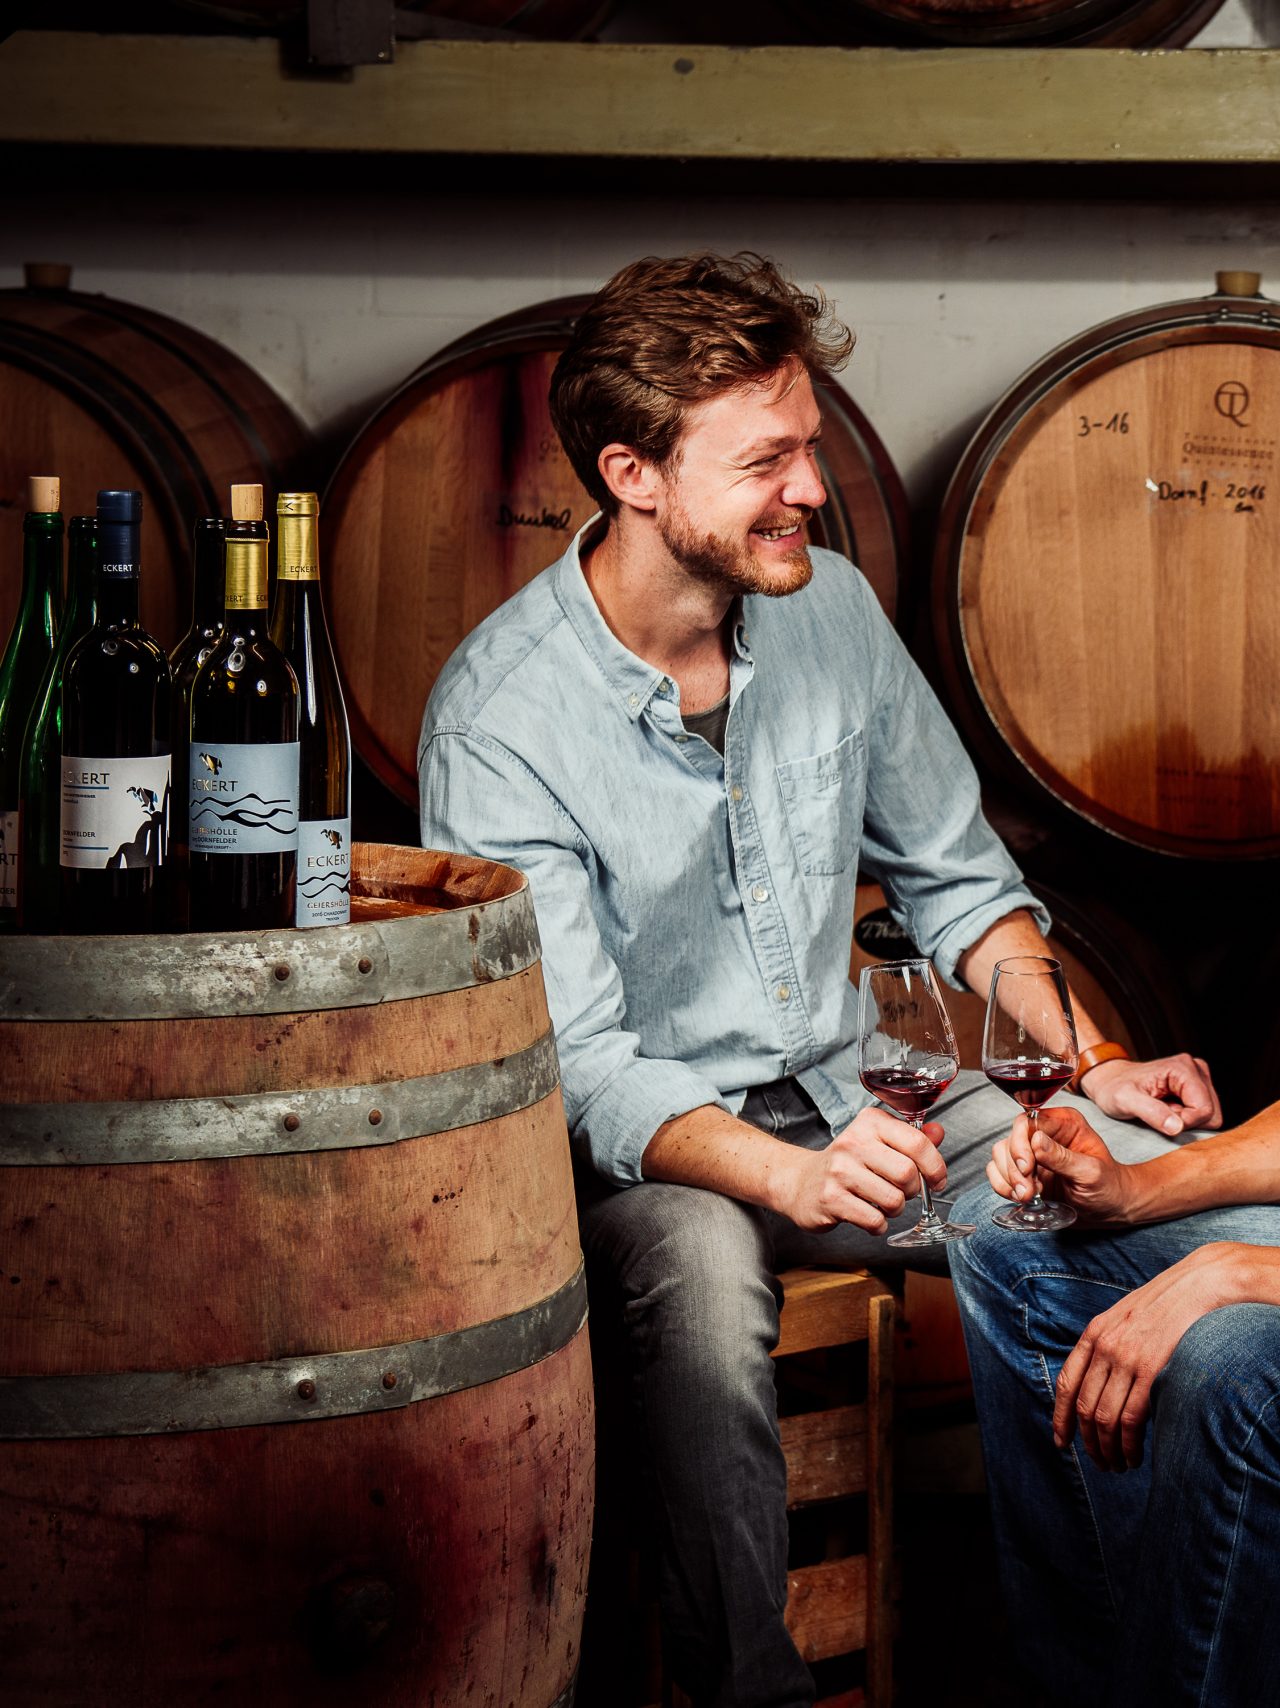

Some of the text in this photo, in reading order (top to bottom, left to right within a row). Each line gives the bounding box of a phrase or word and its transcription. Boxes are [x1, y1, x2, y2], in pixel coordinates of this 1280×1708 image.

[1077, 411, 1130, 437] 3-16
[102, 564, 133, 572] ECKERT
[290, 565, 318, 573] ECKERT
[191, 778, 239, 792] ECKERT
